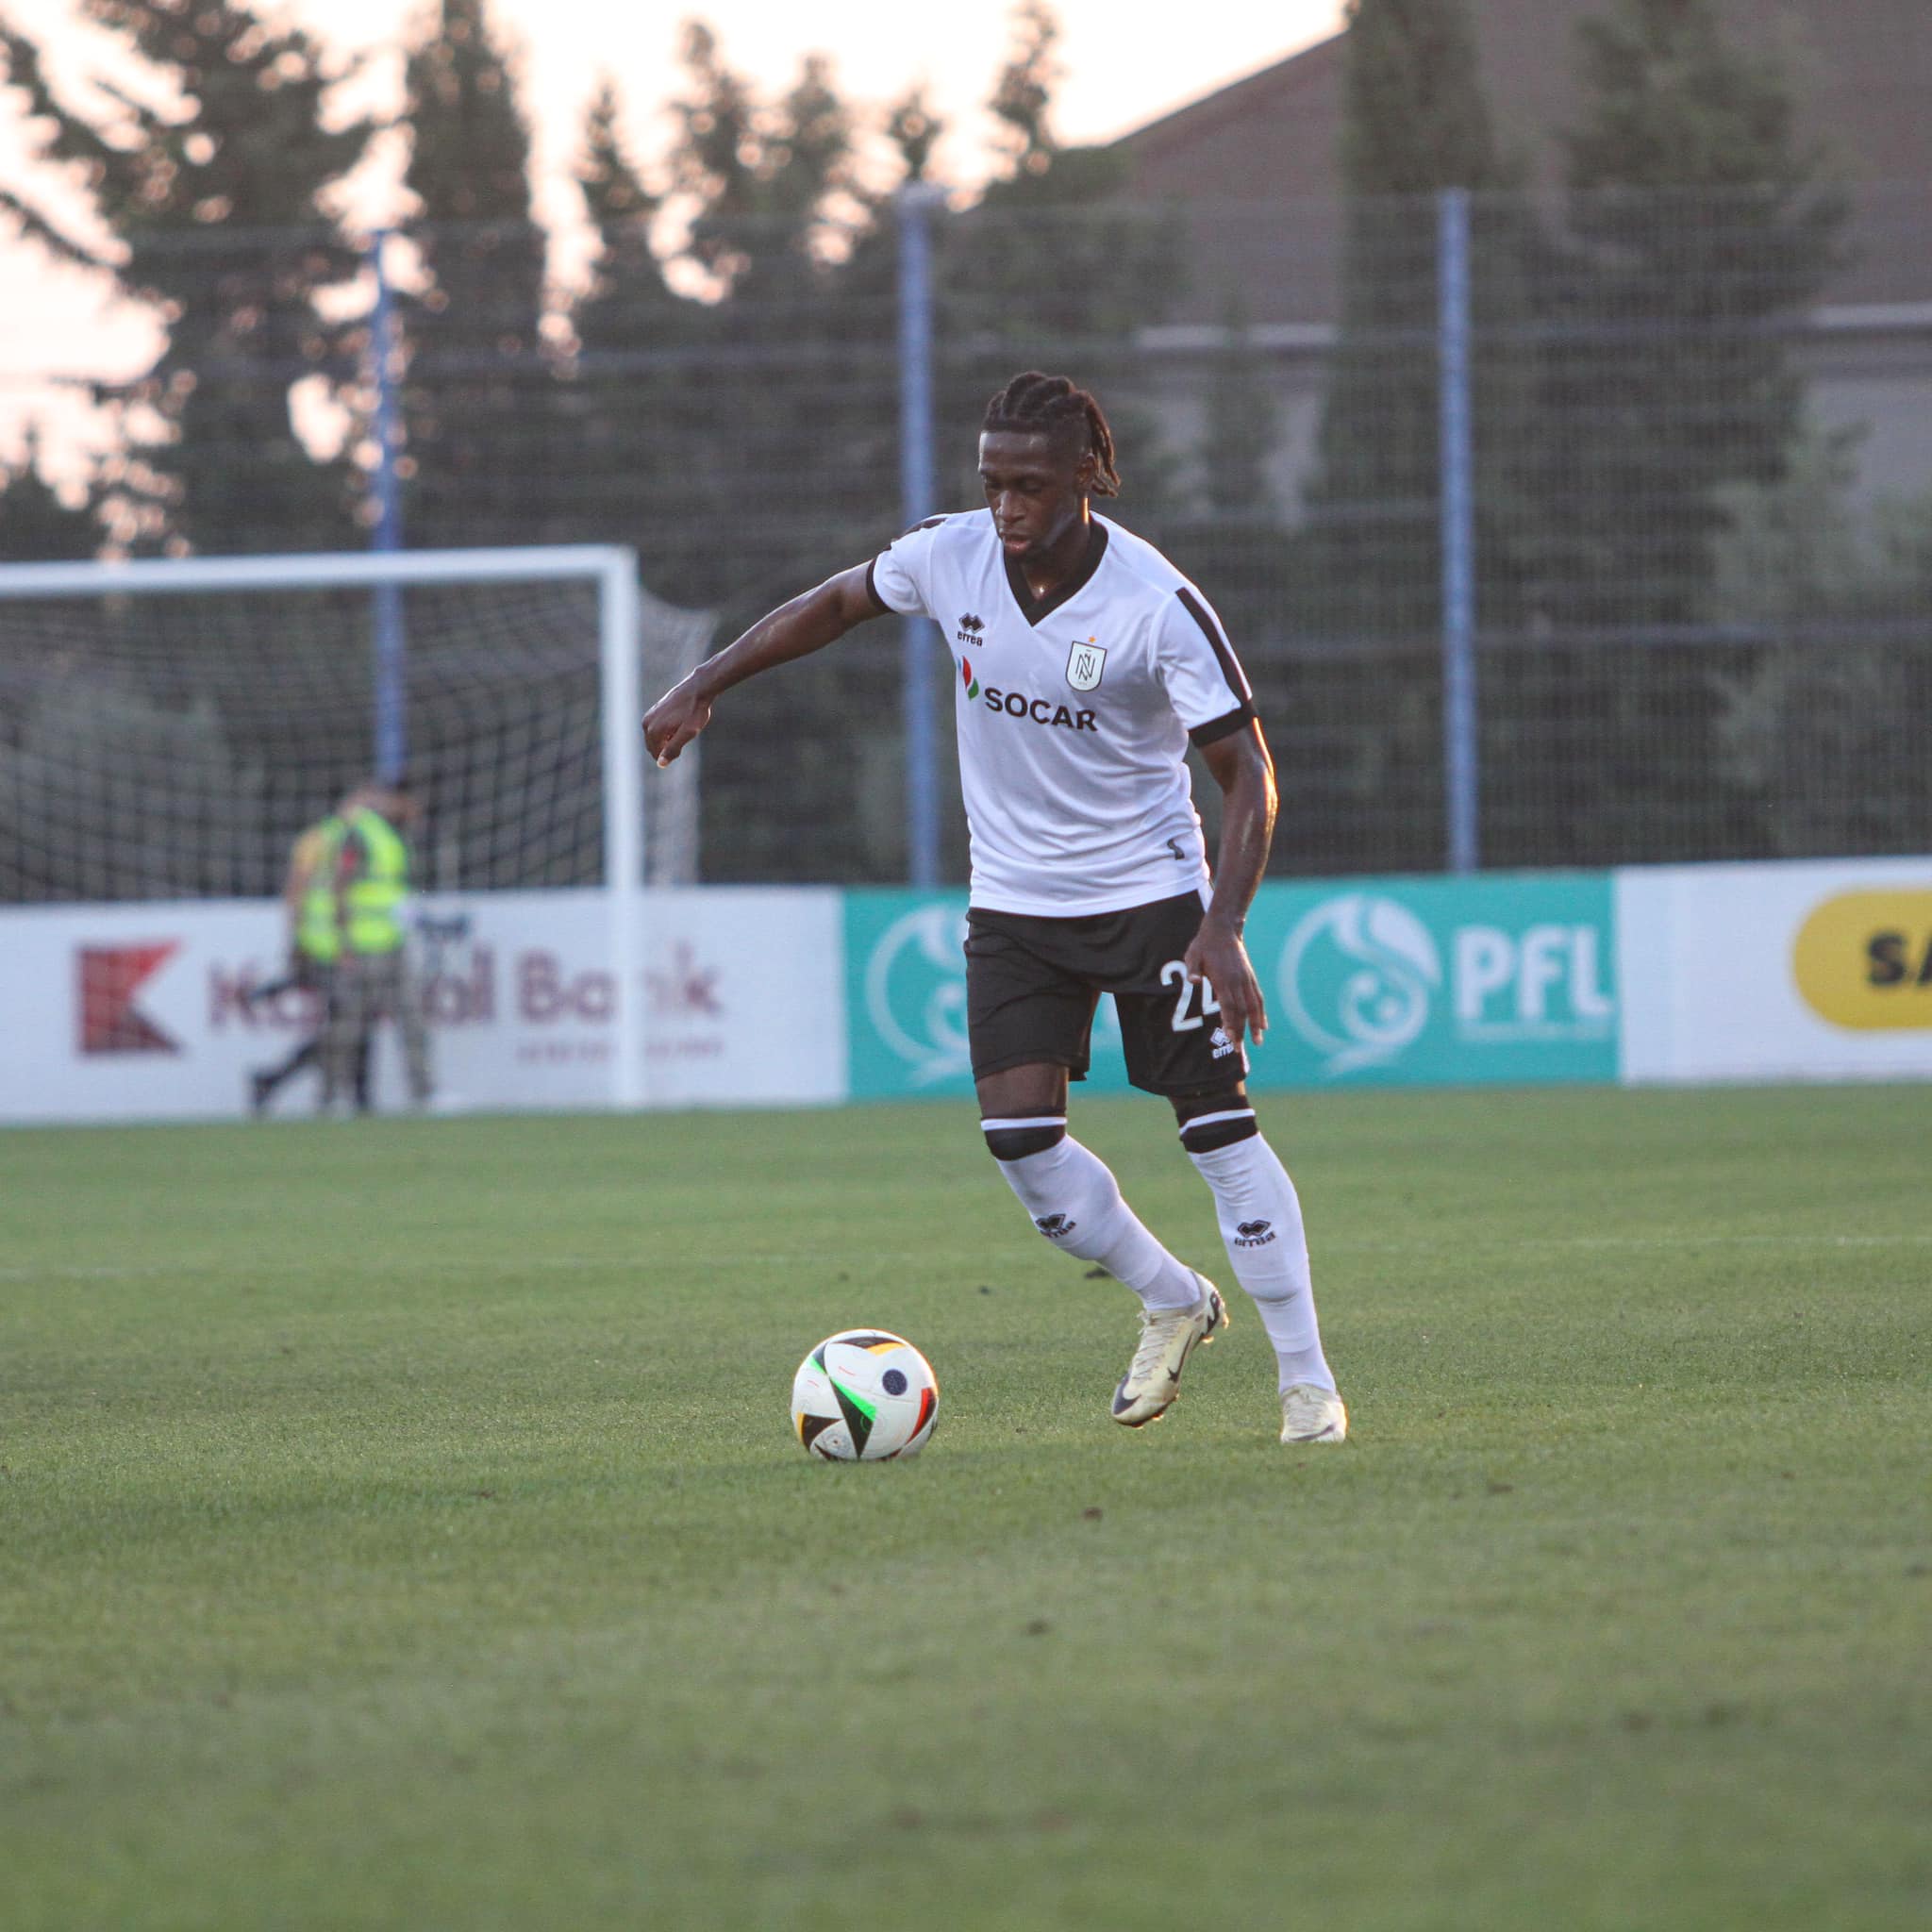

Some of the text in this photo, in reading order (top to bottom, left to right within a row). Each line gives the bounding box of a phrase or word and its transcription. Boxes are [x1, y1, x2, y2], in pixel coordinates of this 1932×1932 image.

[958, 631, 983, 647] errea
[984, 687, 1098, 732] SOCAR
[209, 945, 495, 1028] Kaal
[1455, 924, 1613, 1018] PFL
